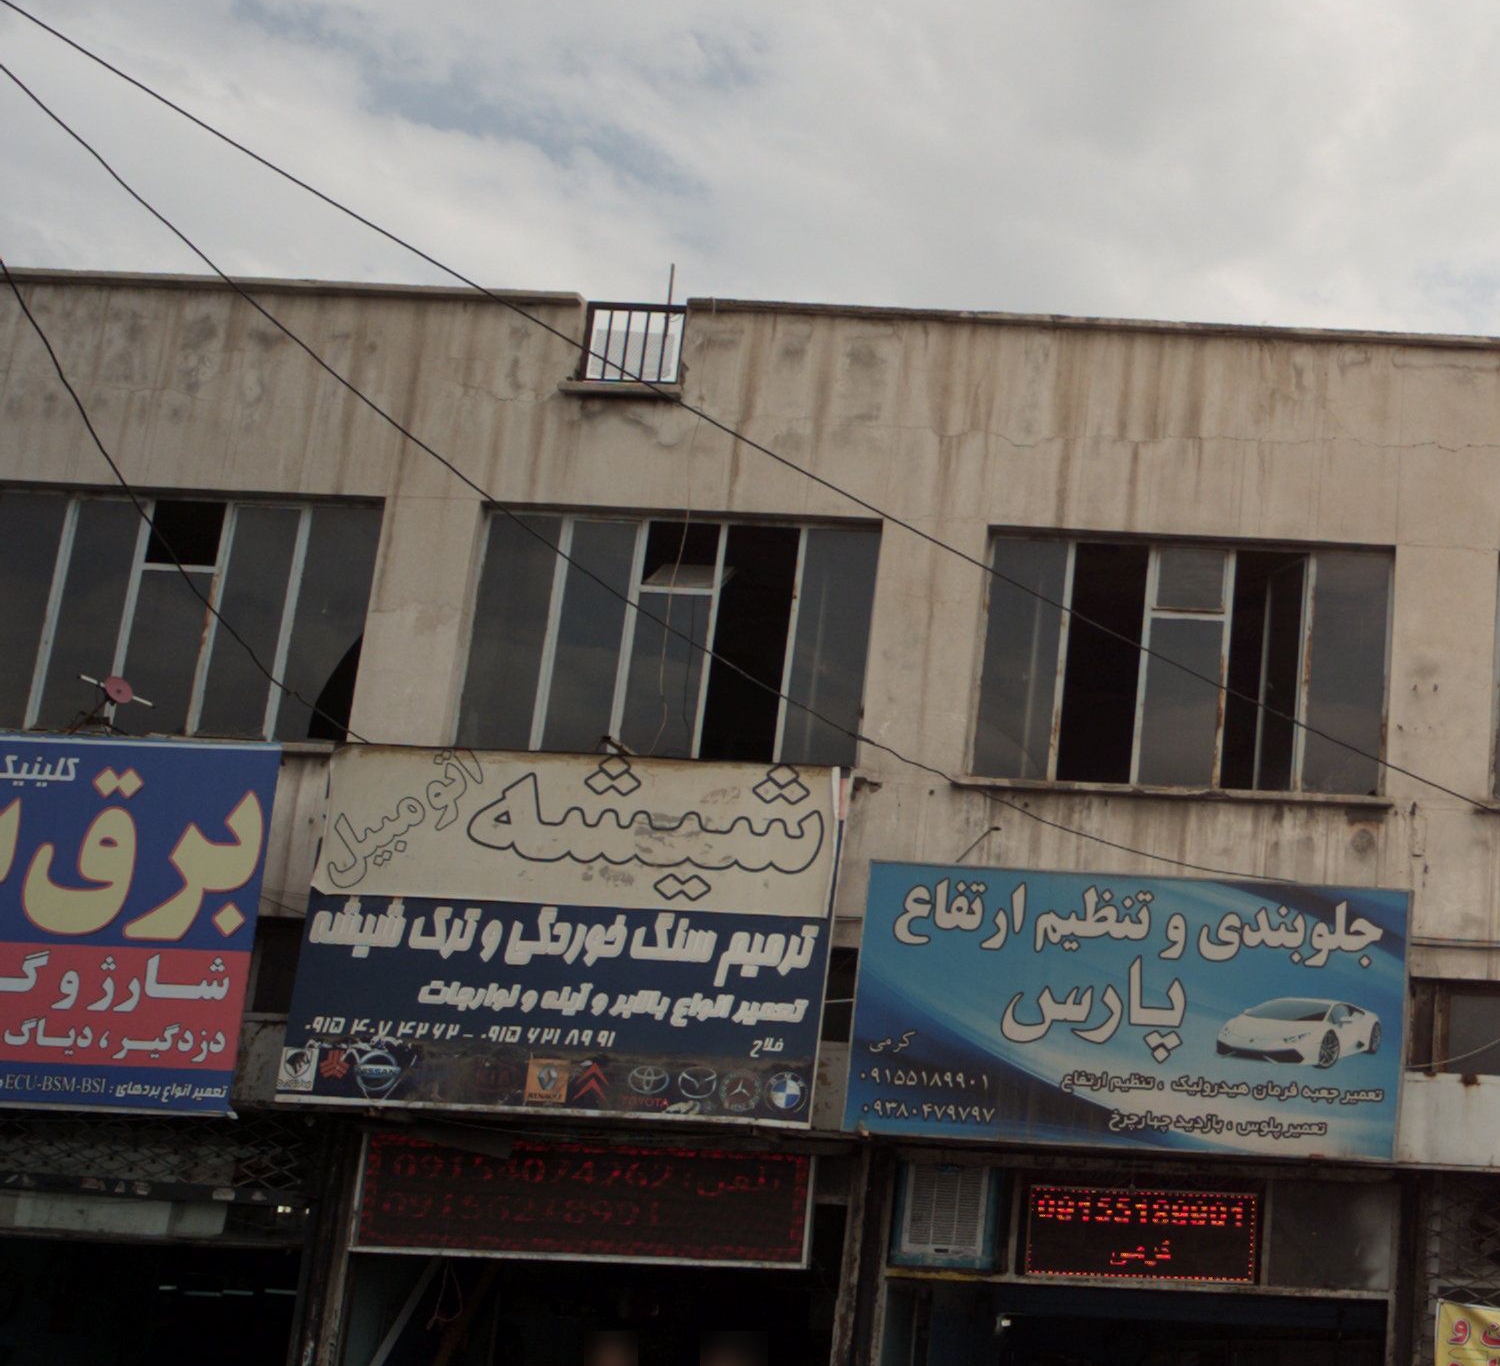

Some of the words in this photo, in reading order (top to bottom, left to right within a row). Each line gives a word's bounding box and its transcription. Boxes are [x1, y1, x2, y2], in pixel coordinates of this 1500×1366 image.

[328, 748, 484, 890] اتومبیل
[465, 753, 826, 902] شیشه
[22, 766, 265, 941] برق
[308, 893, 408, 959] شیشه
[892, 877, 1027, 951] ارتفاع
[1034, 884, 1155, 953] تنظیم
[408, 905, 483, 960] ترک
[478, 918, 504, 964] و
[504, 905, 629, 968] خوردگی
[629, 912, 718, 964] سنگ
[1159, 912, 1187, 962] و
[713, 924, 820, 988] ترمیم
[51, 970, 80, 1010] و
[87, 953, 230, 1012] شارژ
[520, 988, 539, 1014] و
[540, 981, 594, 1017] آینه
[591, 992, 610, 1017] و
[608, 989, 671, 1020] بالابر
[669, 992, 736, 1028] انواع
[731, 998, 810, 1026] تعمیر
[1000, 954, 1188, 1065] پارس
[869, 1030, 917, 1054] کرمی
[6, 1074, 107, 1094] ECU-BSM-BSI
[161, 1082, 192, 1103] انواع
[192, 1085, 229, 1101] تعمیر
[860, 1066, 990, 1091] ۰۹۱۵۵۱۸۹۹۰۱
[1060, 1071, 1109, 1094] ارتفاع
[1109, 1073, 1155, 1092] تنظیم
[1253, 1082, 1299, 1102] فرمان
[1302, 1086, 1340, 1103] جعبه
[1342, 1087, 1385, 1104] تعمیر
[862, 1098, 996, 1123] ۰۹۳۸۰۴۷۹۷۹۷
[1174, 1113, 1225, 1135] بازدید
[1236, 1116, 1288, 1140] پلوس
[1286, 1120, 1328, 1137] تعمیر
[1447, 1318, 1471, 1345] و
